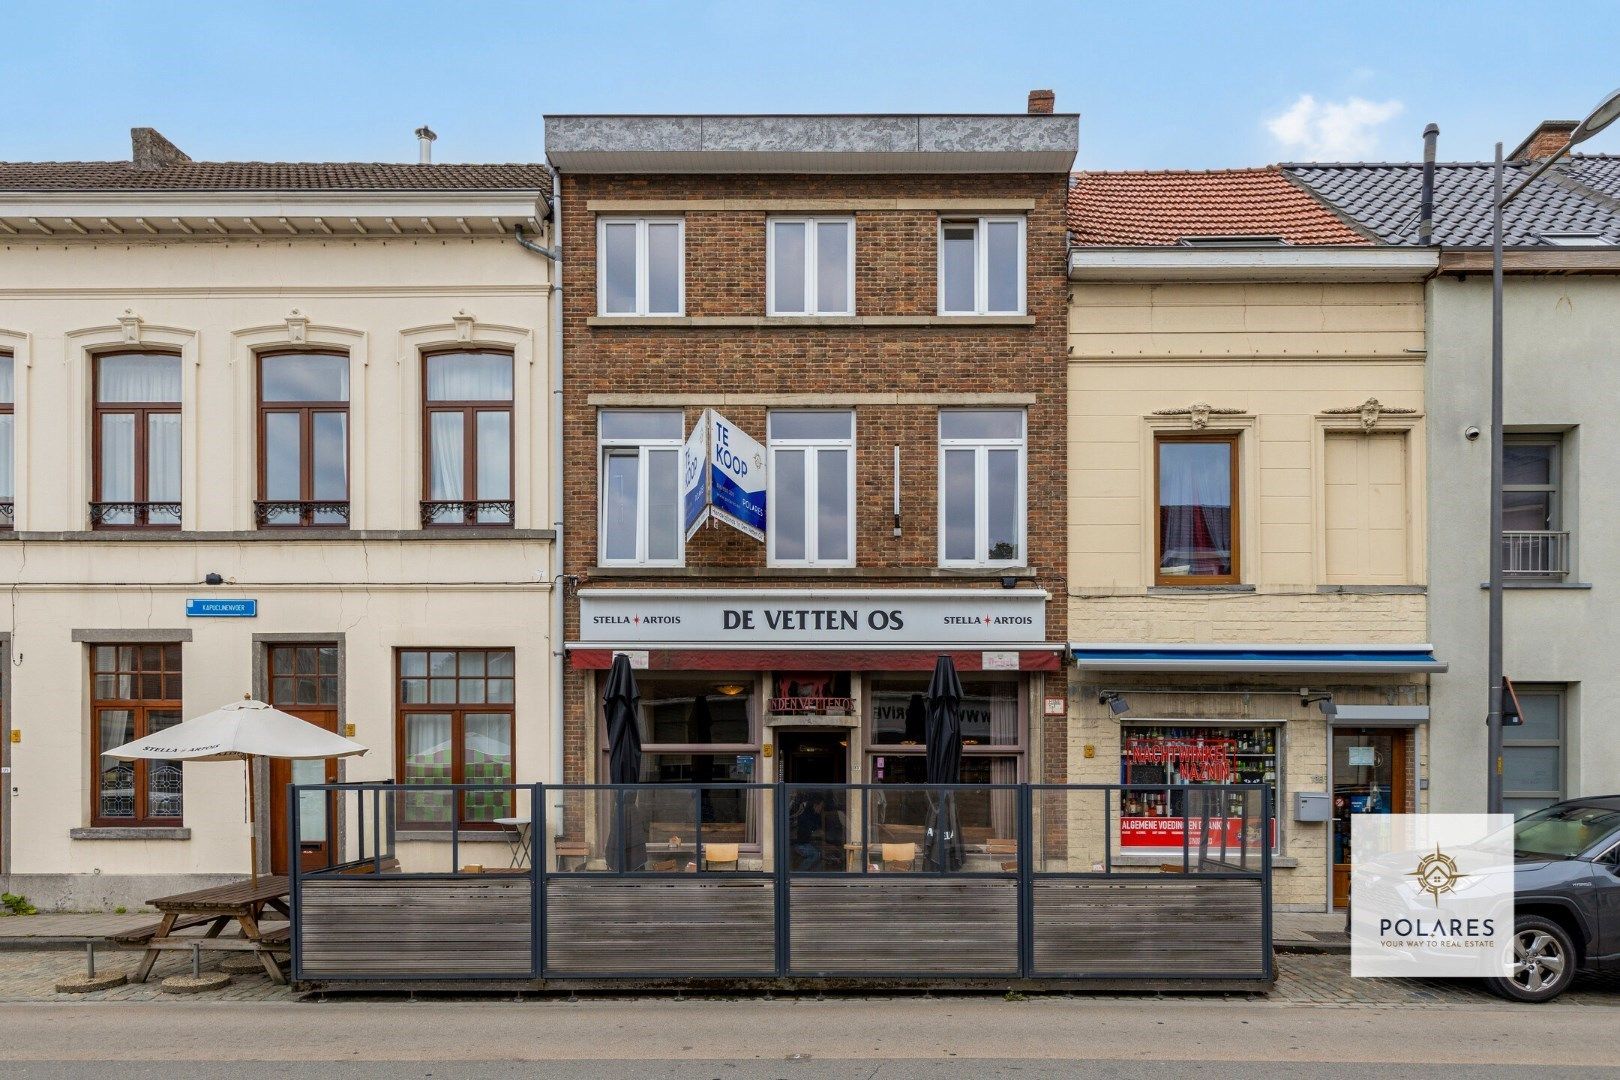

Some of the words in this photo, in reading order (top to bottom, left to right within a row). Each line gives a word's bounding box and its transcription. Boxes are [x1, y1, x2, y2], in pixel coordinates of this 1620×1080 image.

[716, 421, 729, 447] TE
[716, 444, 748, 478] KOOP
[593, 616, 630, 624] STELLA
[642, 616, 681, 624] ARTOIS
[723, 609, 755, 630] DE
[764, 609, 858, 630] VETTEN
[867, 609, 904, 631] OS
[943, 616, 981, 625] STELLA
[993, 616, 1032, 625] ARTOIS
[142, 745, 178, 753] STELLA
[1180, 763, 1230, 780] NAZNIN
[1121, 820, 1158, 830] ALGEMENE
[1158, 820, 1185, 830] VOEDIN
[1188, 820, 1197, 830] EN
